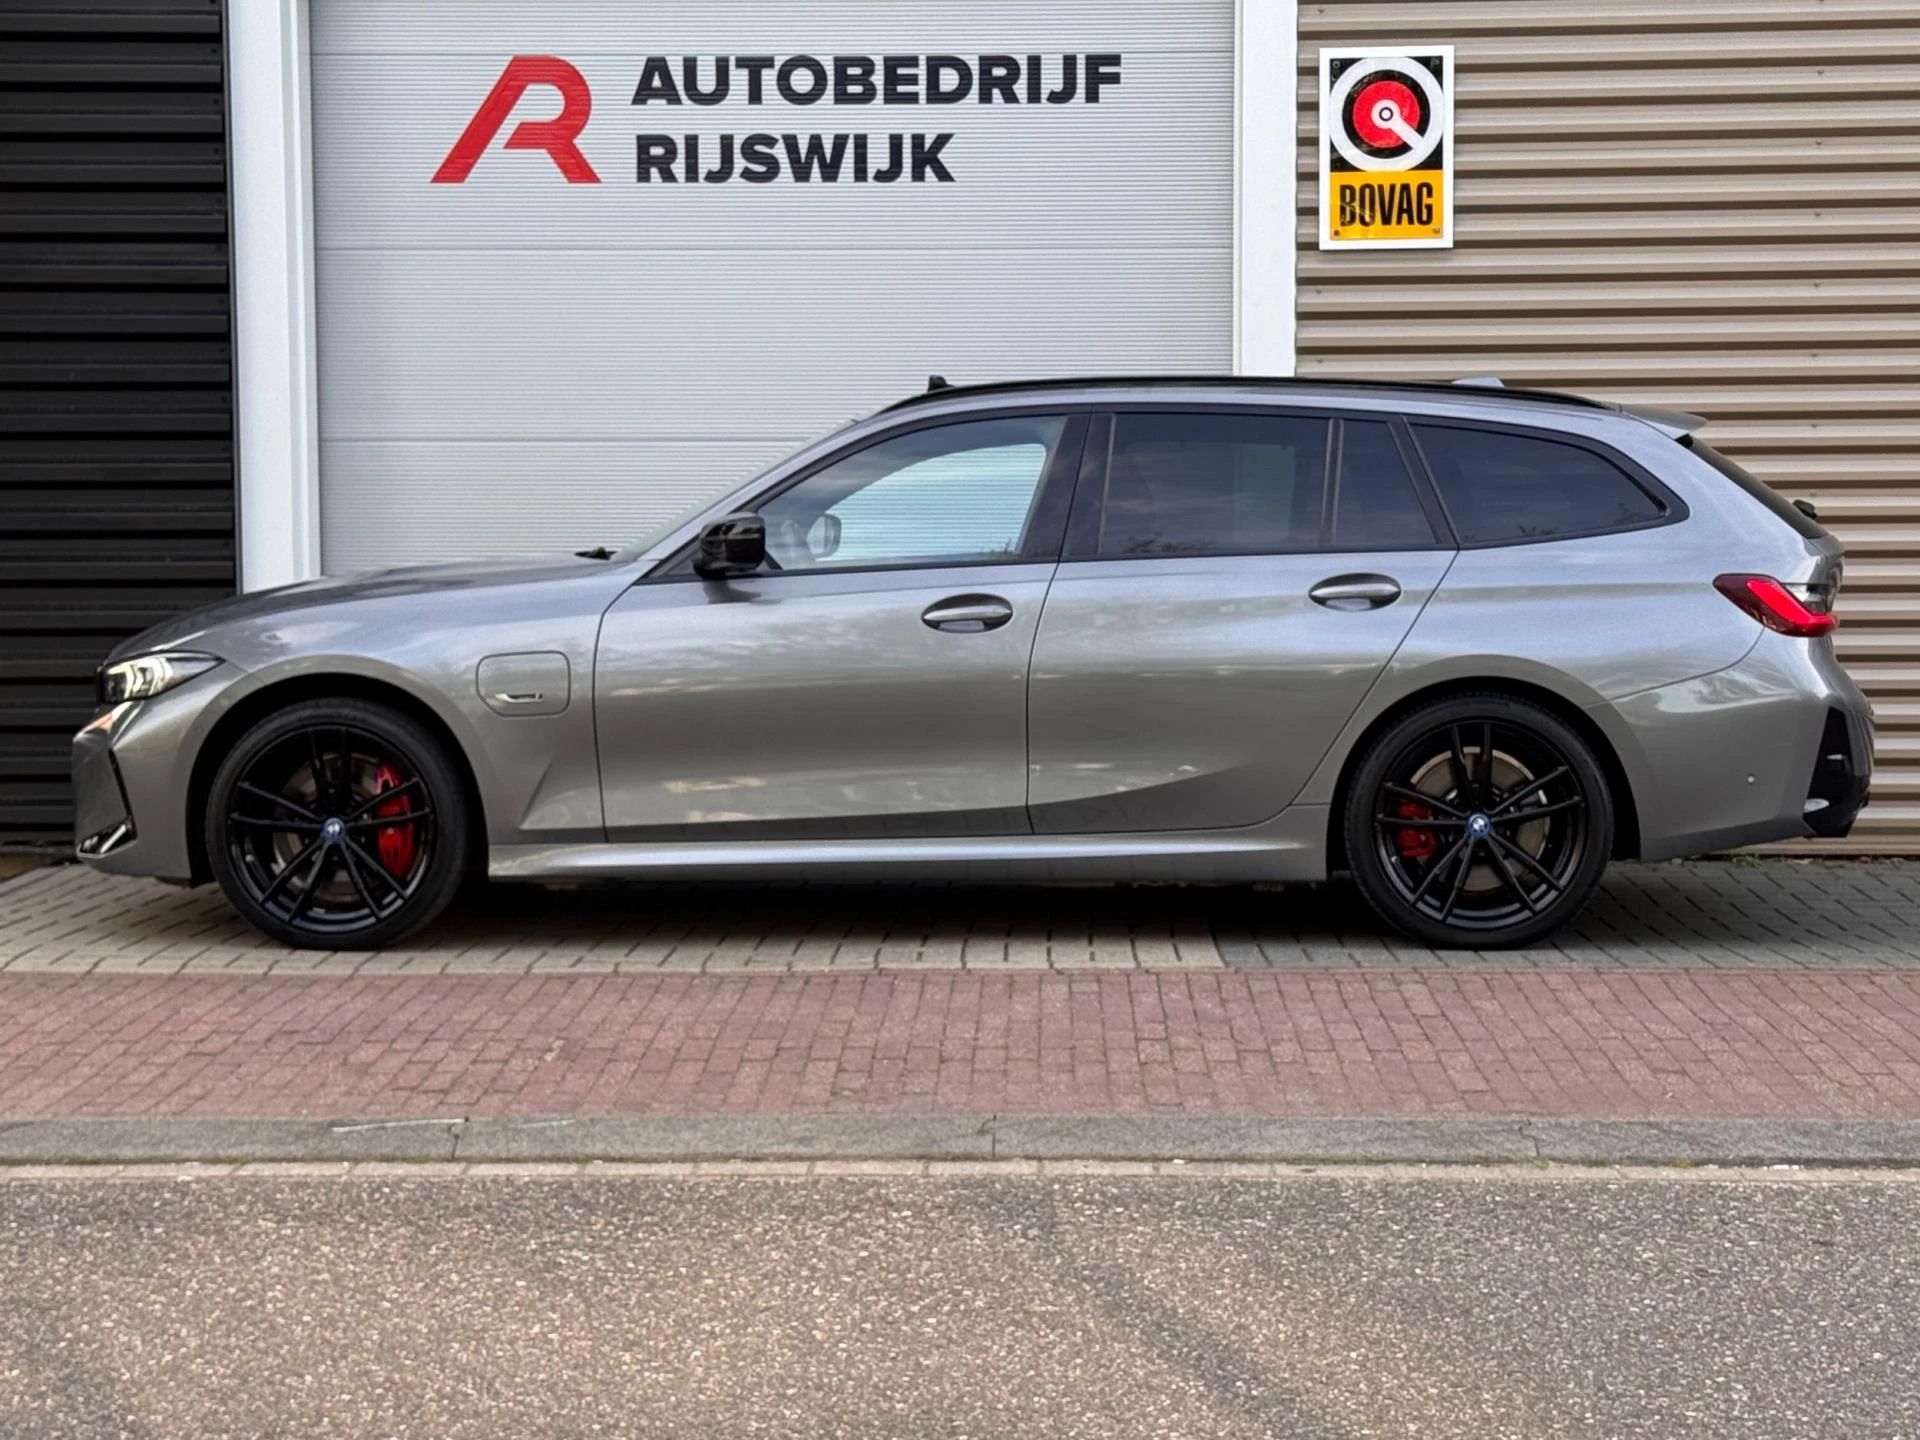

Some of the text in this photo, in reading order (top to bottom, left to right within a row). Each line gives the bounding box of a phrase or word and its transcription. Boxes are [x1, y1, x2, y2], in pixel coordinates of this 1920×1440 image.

[631, 54, 1122, 105] AUTOBEDRIJF
[636, 134, 956, 183] RIJSWIJK
[1339, 182, 1434, 227] BOVAG
